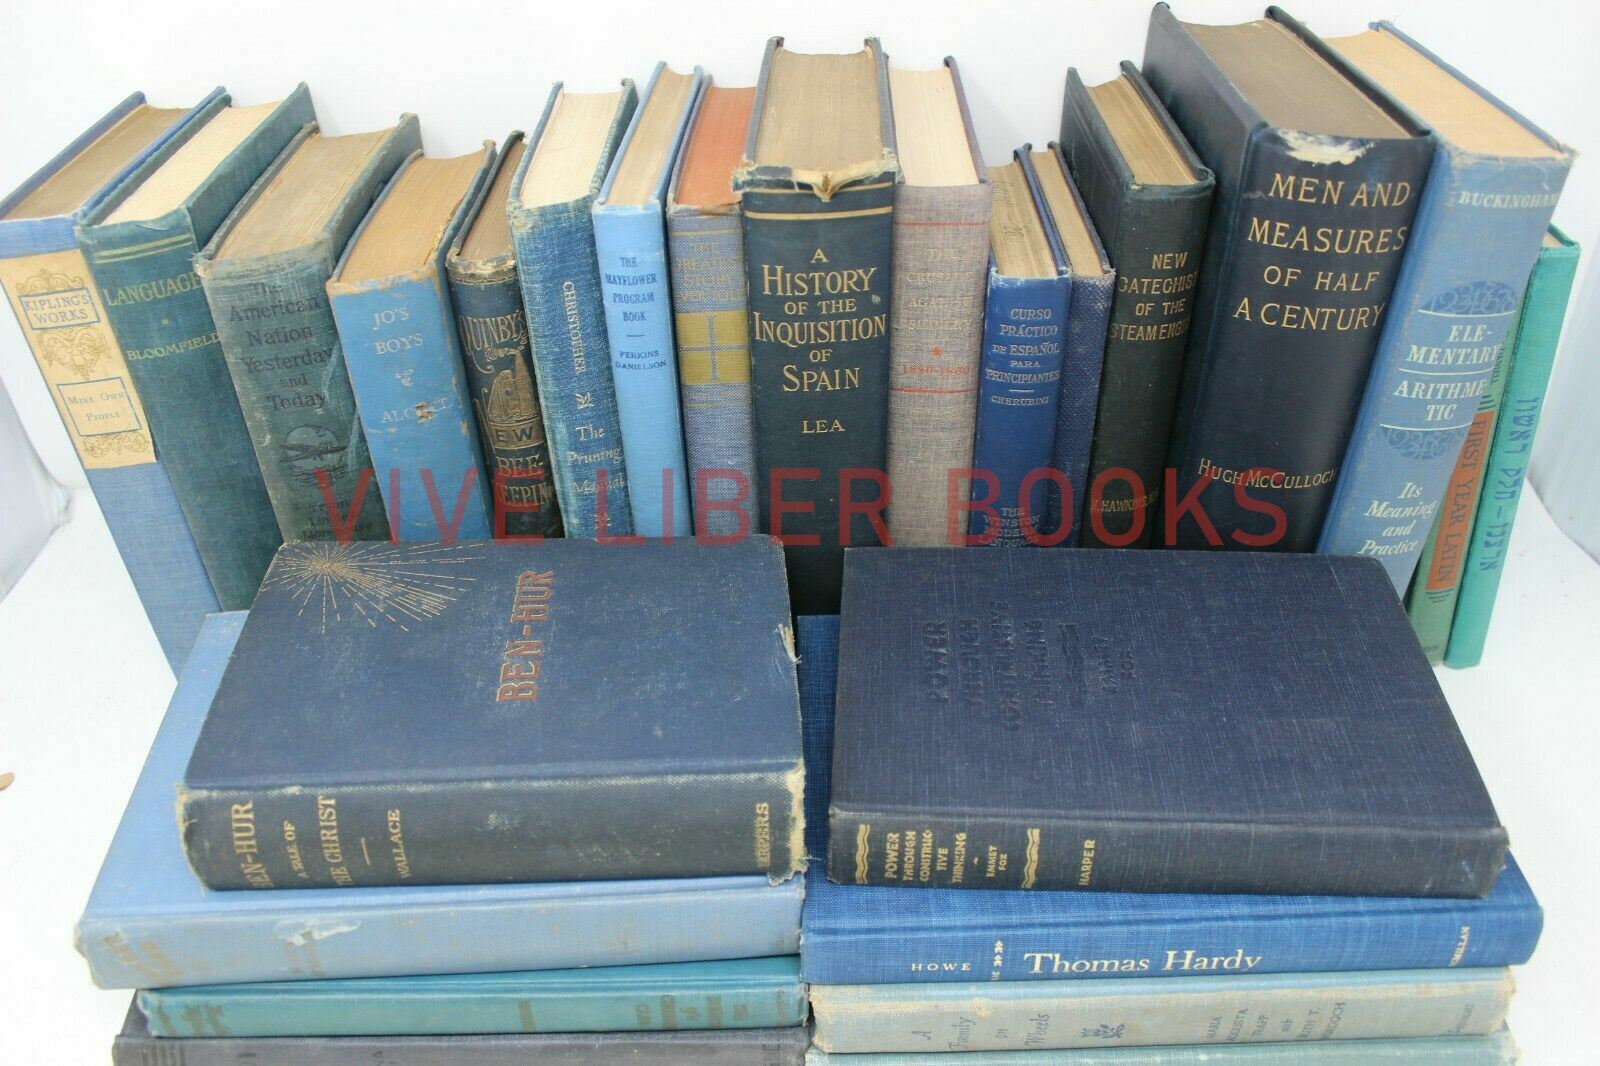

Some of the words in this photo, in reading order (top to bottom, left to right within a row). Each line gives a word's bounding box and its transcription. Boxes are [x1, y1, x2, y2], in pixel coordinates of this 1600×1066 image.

[1269, 173, 1345, 205] MEN
[1350, 182, 1411, 207] AND
[1247, 217, 1408, 254] MEASURES
[619, 257, 638, 268] THE
[810, 248, 829, 263] A
[1152, 252, 1188, 270] NEW
[102, 271, 203, 306] LANGUAGE
[605, 273, 657, 286] MAYFLOWER
[761, 264, 877, 296] HISTORY
[1263, 265, 1301, 287] OF
[1314, 271, 1381, 292] HALF
[612, 292, 655, 304] PROGRAM
[784, 301, 808, 315] OF
[817, 298, 857, 314] THE
[1135, 303, 1155, 316] OF
[1163, 298, 1186, 315] THE
[33, 308, 88, 324] WORKS
[230, 297, 319, 322] American
[372, 307, 409, 331] JO'S
[623, 311, 647, 322] BOOK
[1010, 308, 1052, 320] CURSO
[1233, 297, 1252, 322] A
[1261, 301, 1386, 331] CENTURY
[244, 326, 313, 347] Nation
[563, 281, 586, 374] CHRISTOPHER
[753, 311, 887, 348] INQUISITION
[1158, 317, 1190, 340] ENG
[1447, 325, 1492, 342] ELE-
[127, 332, 221, 360] BLOOMFIELD
[375, 333, 423, 355] BOYS
[619, 351, 659, 359] PERKINS
[1406, 344, 1502, 366] MENTARY
[240, 347, 334, 373] Yesterday
[615, 360, 667, 370] DANIELSON
[809, 349, 833, 363] OF
[280, 373, 308, 387] and
[782, 365, 860, 392] SPAIN
[986, 368, 1060, 384] PRINCIPIANTES
[265, 393, 325, 411] Today
[991, 395, 1050, 406] CHERUBINI
[1425, 404, 1458, 421] TIC
[576, 424, 604, 442] The
[802, 419, 845, 434] LEA
[567, 447, 623, 465] Pruning
[1461, 420, 1487, 470] FIRST
[1198, 457, 1243, 486] HUGH
[494, 480, 553, 507] EEPIN
[1397, 482, 1423, 499] Its
[1448, 478, 1474, 524] YEAR
[1364, 500, 1441, 520] Meaning
[1382, 521, 1416, 537] and
[1357, 539, 1419, 555] Practice
[1437, 532, 1463, 582] LATIN
[496, 570, 555, 702] BEN-HUR
[283, 820, 296, 841] OF
[317, 795, 343, 863] CHRIST
[388, 808, 411, 878] WALLACE
[287, 845, 305, 871] TALE
[885, 832, 900, 879] POWER
[902, 831, 916, 880] THROUGH
[936, 847, 948, 871] TIVE
[952, 832, 967, 883] THINKING
[986, 845, 997, 877] EMMET
[998, 853, 1008, 871] FOX
[1078, 839, 1096, 886] HARPER
[911, 963, 971, 972] HOWE
[1024, 952, 1150, 974] Thomas
[1162, 949, 1262, 974] Hardy
